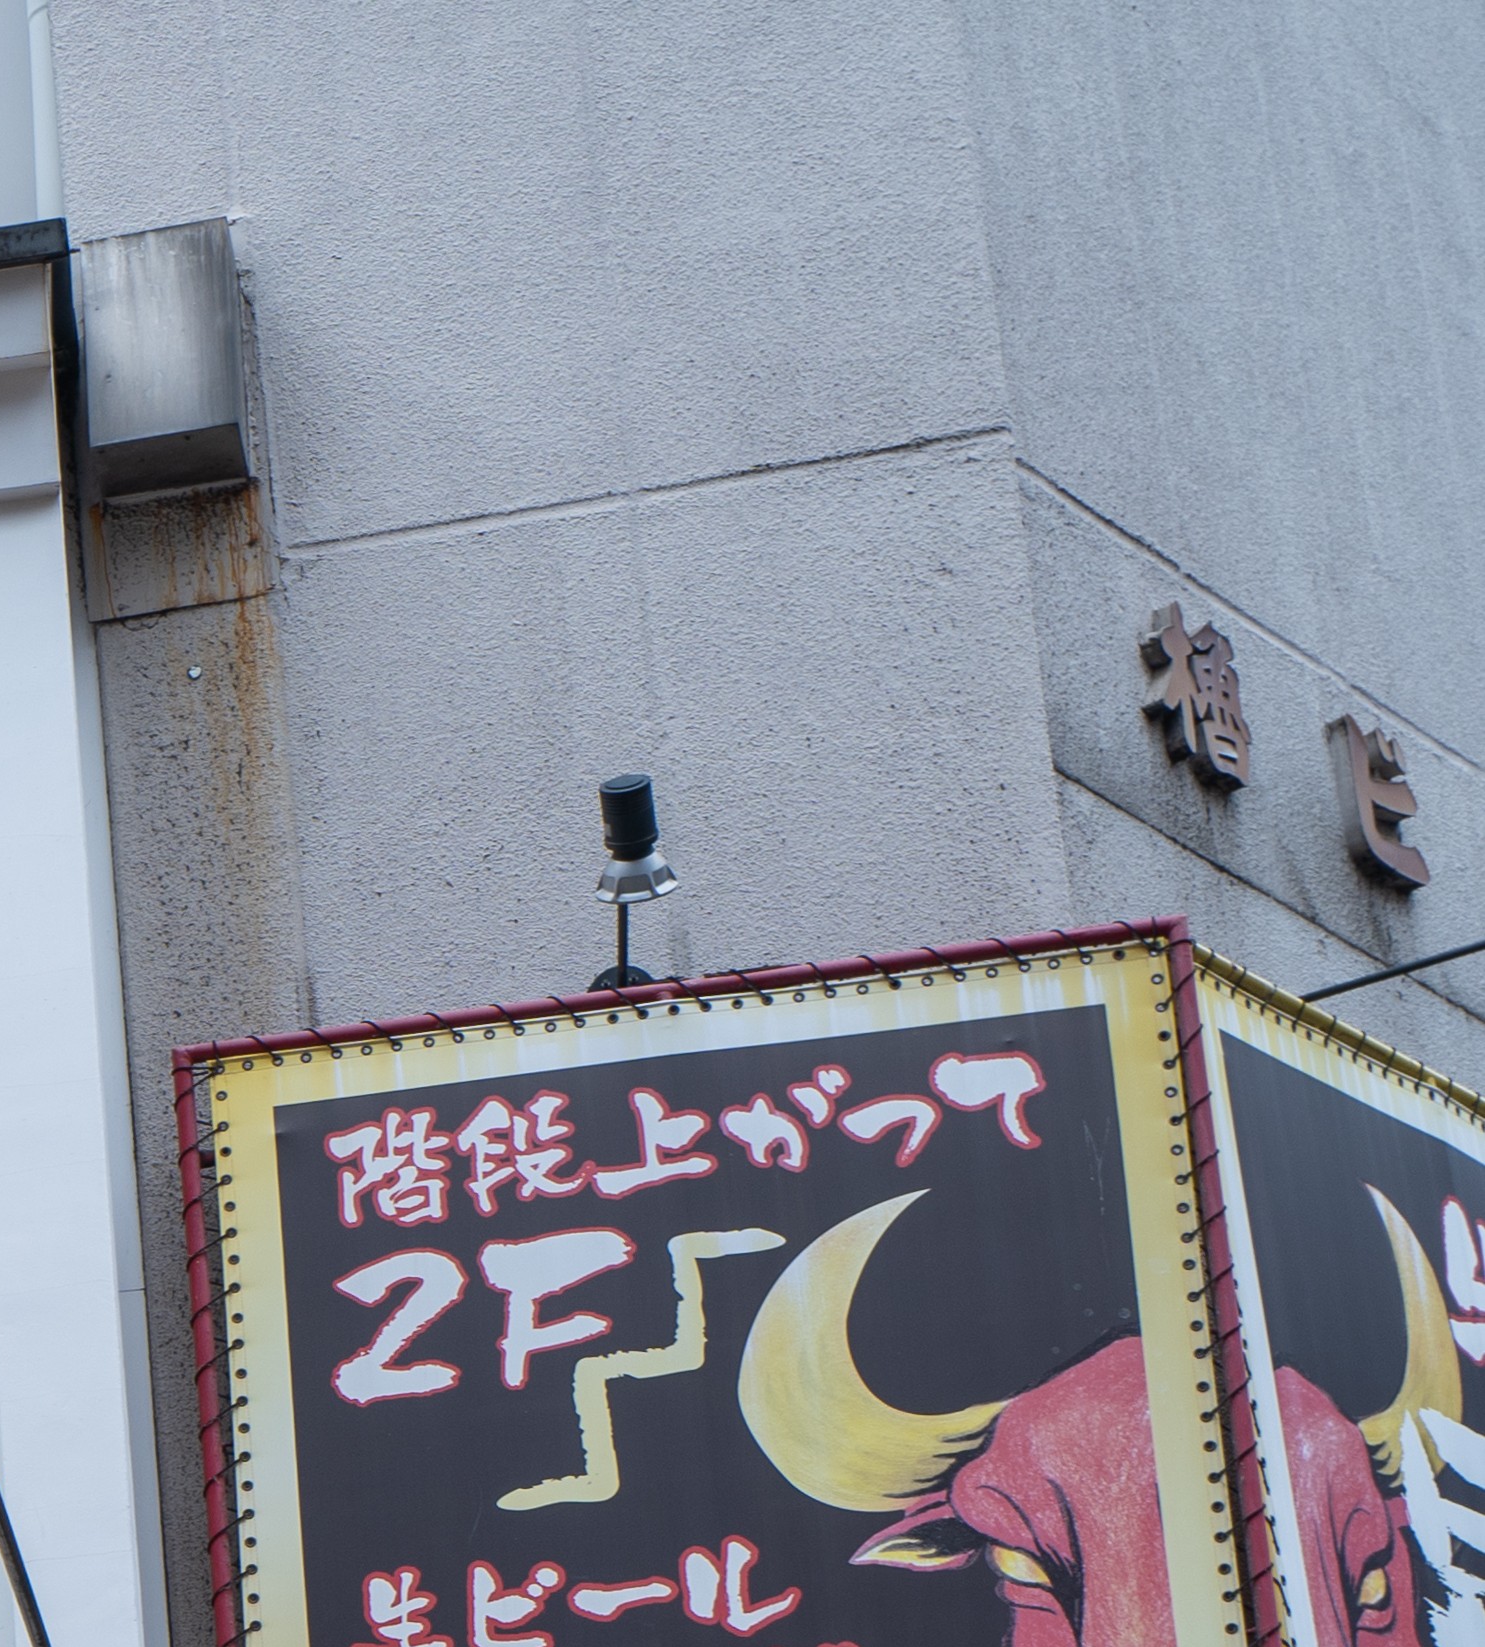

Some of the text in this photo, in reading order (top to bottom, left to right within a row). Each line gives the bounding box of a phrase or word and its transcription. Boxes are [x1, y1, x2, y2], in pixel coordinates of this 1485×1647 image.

[325, 1051, 1046, 1227] 階段上がって
[333, 1227, 637, 1407] 2F
